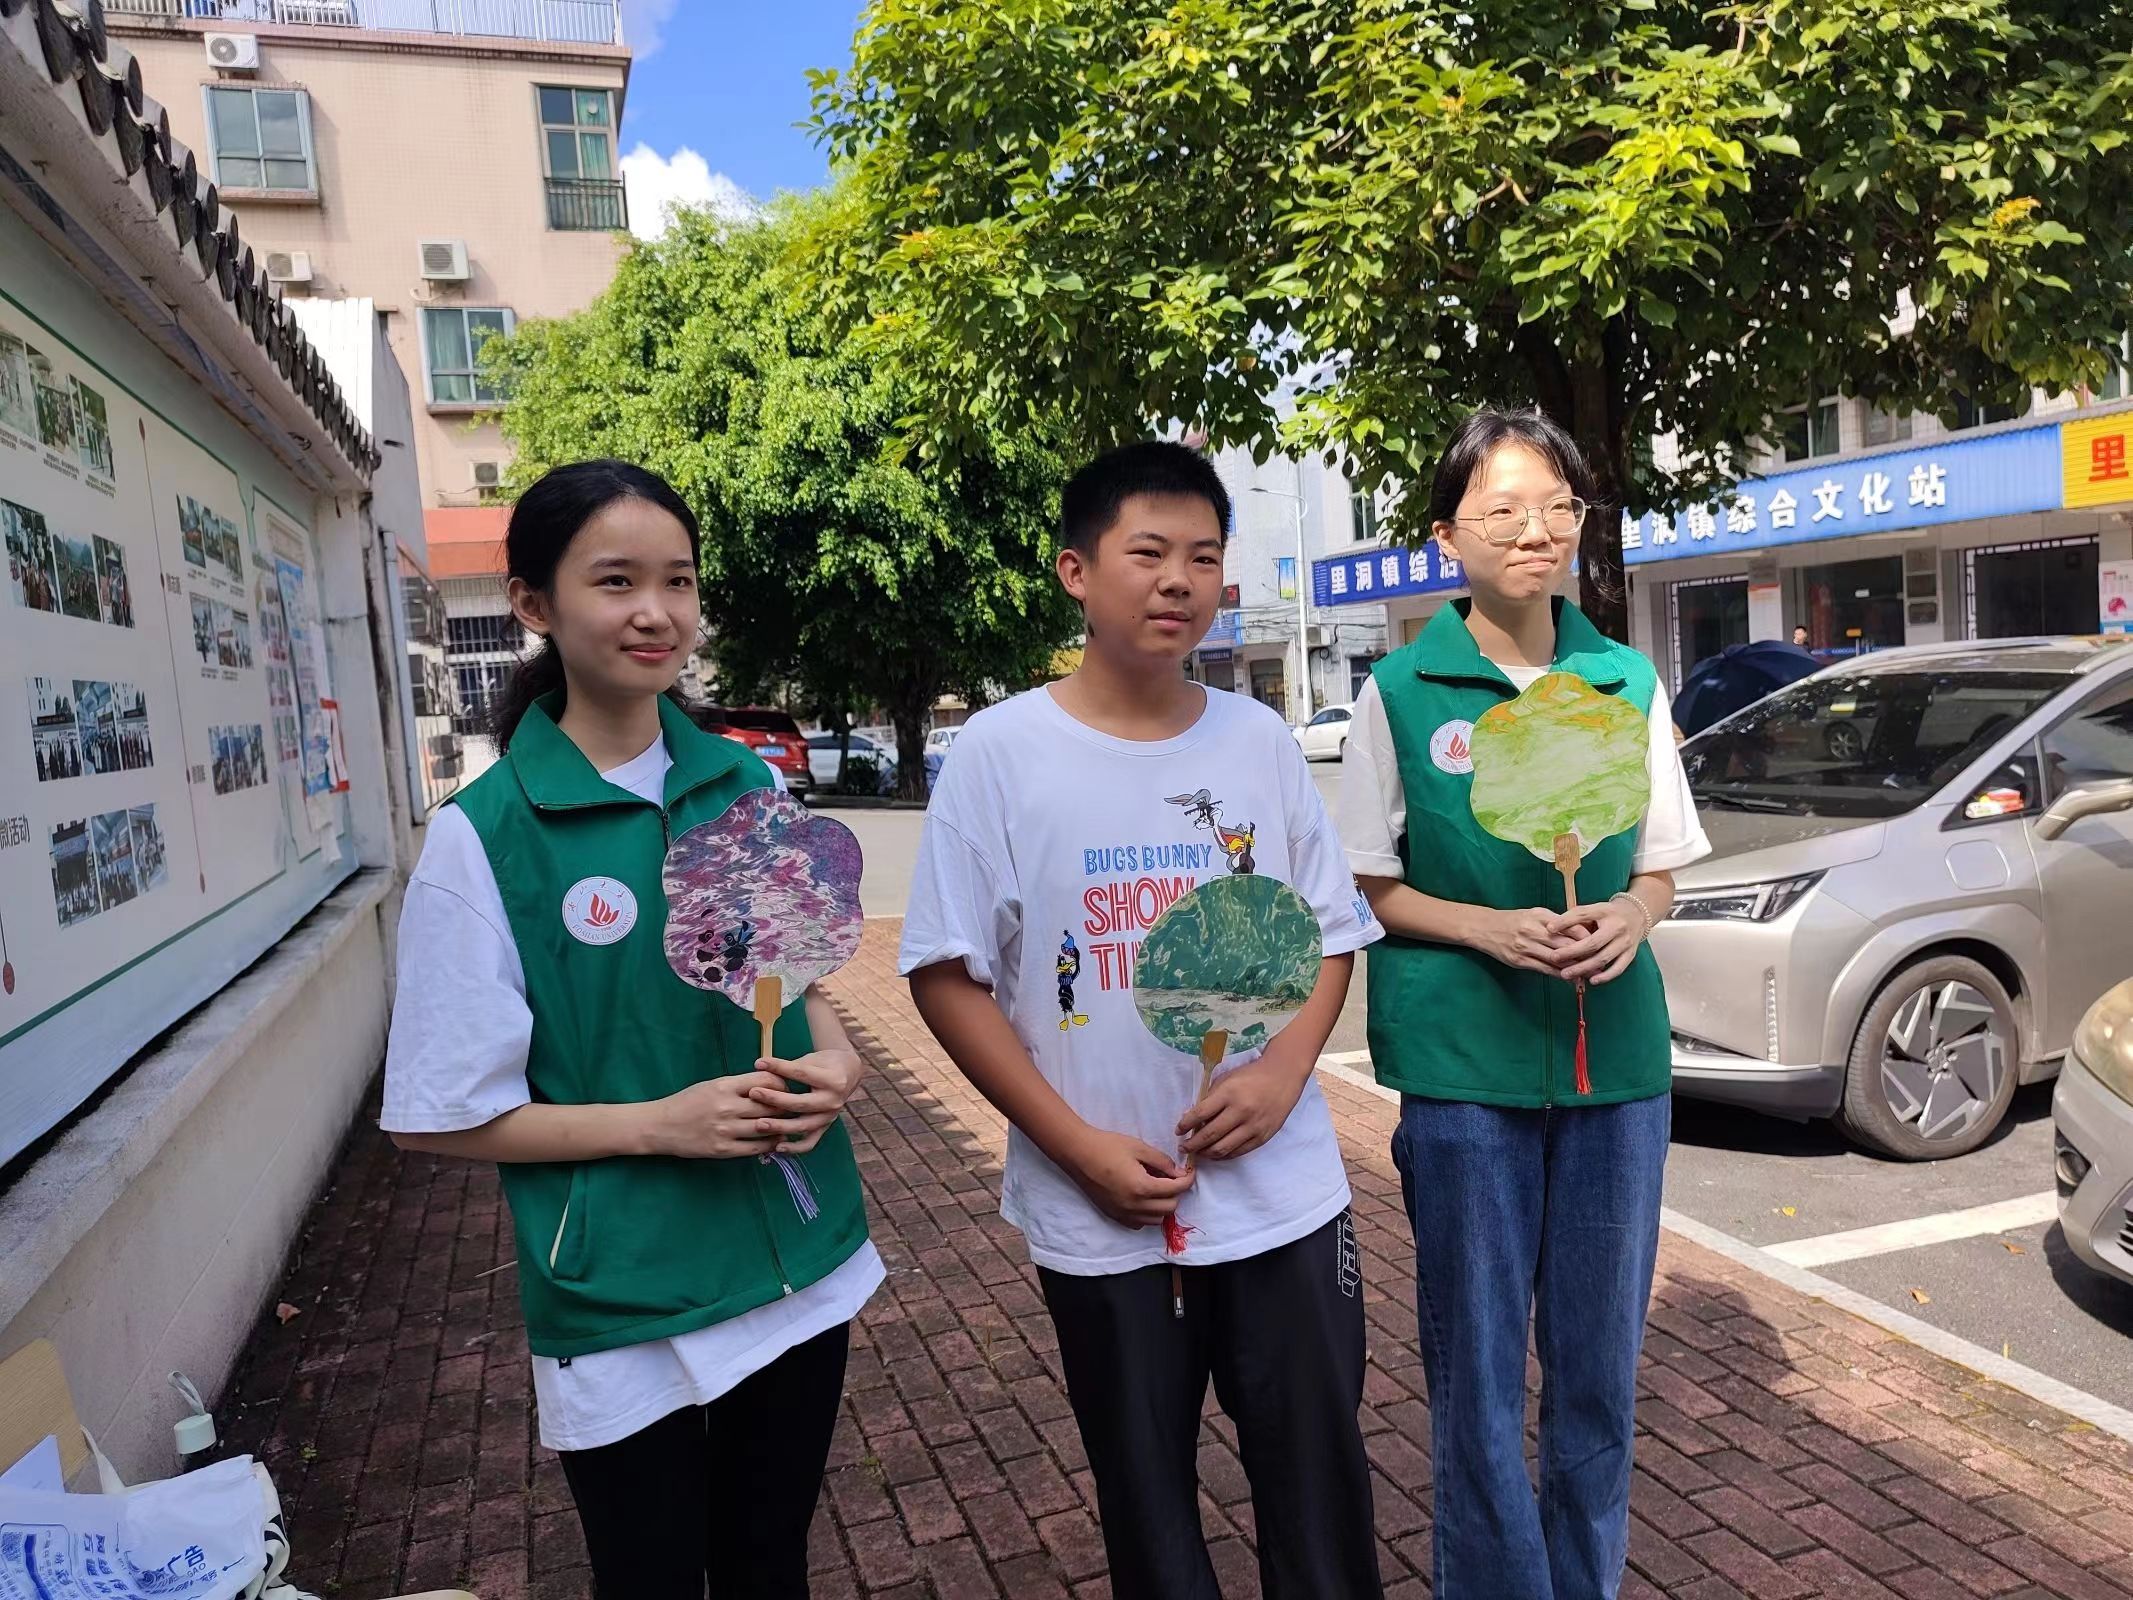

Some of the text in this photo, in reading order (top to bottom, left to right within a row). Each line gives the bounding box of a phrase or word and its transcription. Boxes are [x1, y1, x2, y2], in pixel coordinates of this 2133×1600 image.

[2088, 433, 2129, 482] 里
[1083, 843, 1212, 876] BUGS BUNNY
[1089, 940, 1142, 991] TI
